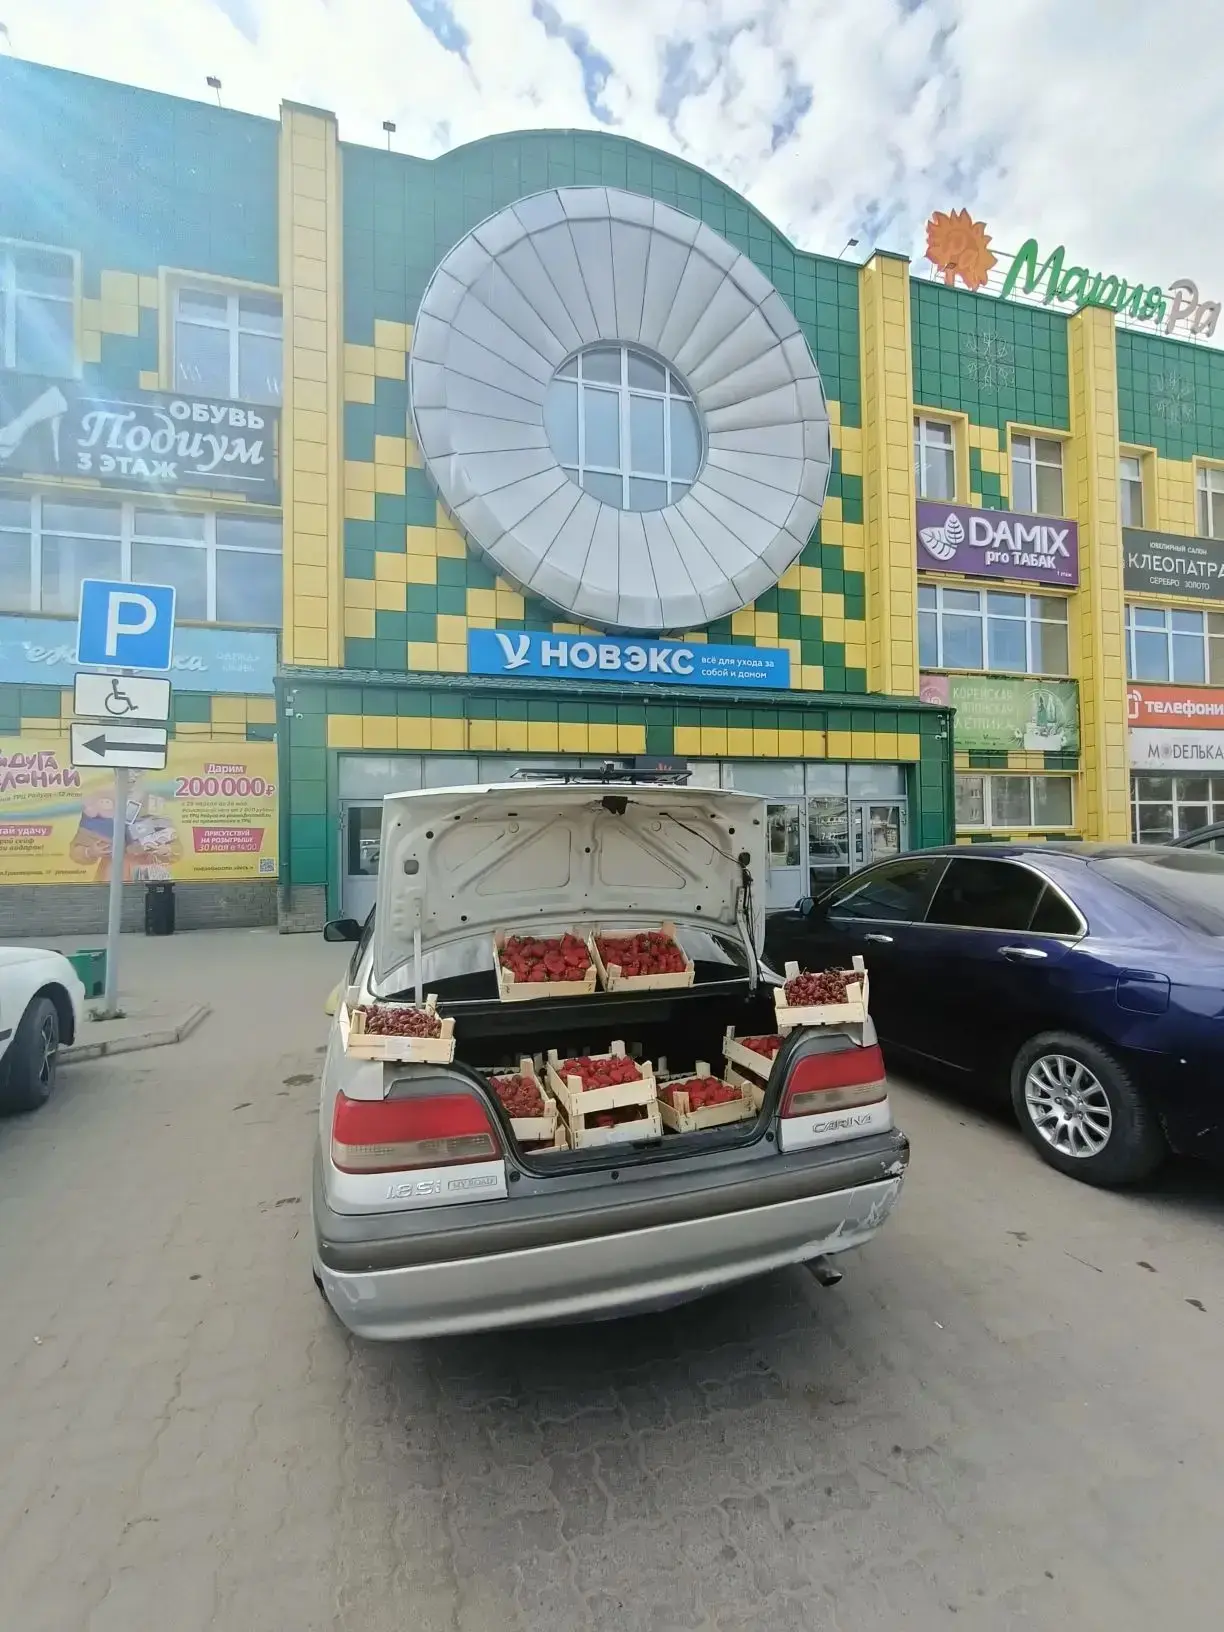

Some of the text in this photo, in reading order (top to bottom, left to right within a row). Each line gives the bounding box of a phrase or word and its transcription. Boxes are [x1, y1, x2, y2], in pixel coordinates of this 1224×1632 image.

[169, 401, 264, 429] ОБУВЬ
[77, 411, 265, 471] Подиум
[78, 453, 179, 479] 3 ЭТАЖ
[968, 516, 1070, 558] DAMIX
[1150, 542, 1207, 555] ЮВЕЛИРНЫЙ САЛОН
[985, 551, 1056, 570] pro ТАБАК
[1150, 577, 1210, 590] СЕРЕБРО ЗОЛОТО
[105, 591, 157, 657] P
[540, 640, 694, 676] НОВЭКС
[702, 656, 775, 668] всё для ухода за
[701, 668, 728, 676] собой
[207, 764, 244, 774] Дарим
[813, 1113, 873, 1134] CARINA
